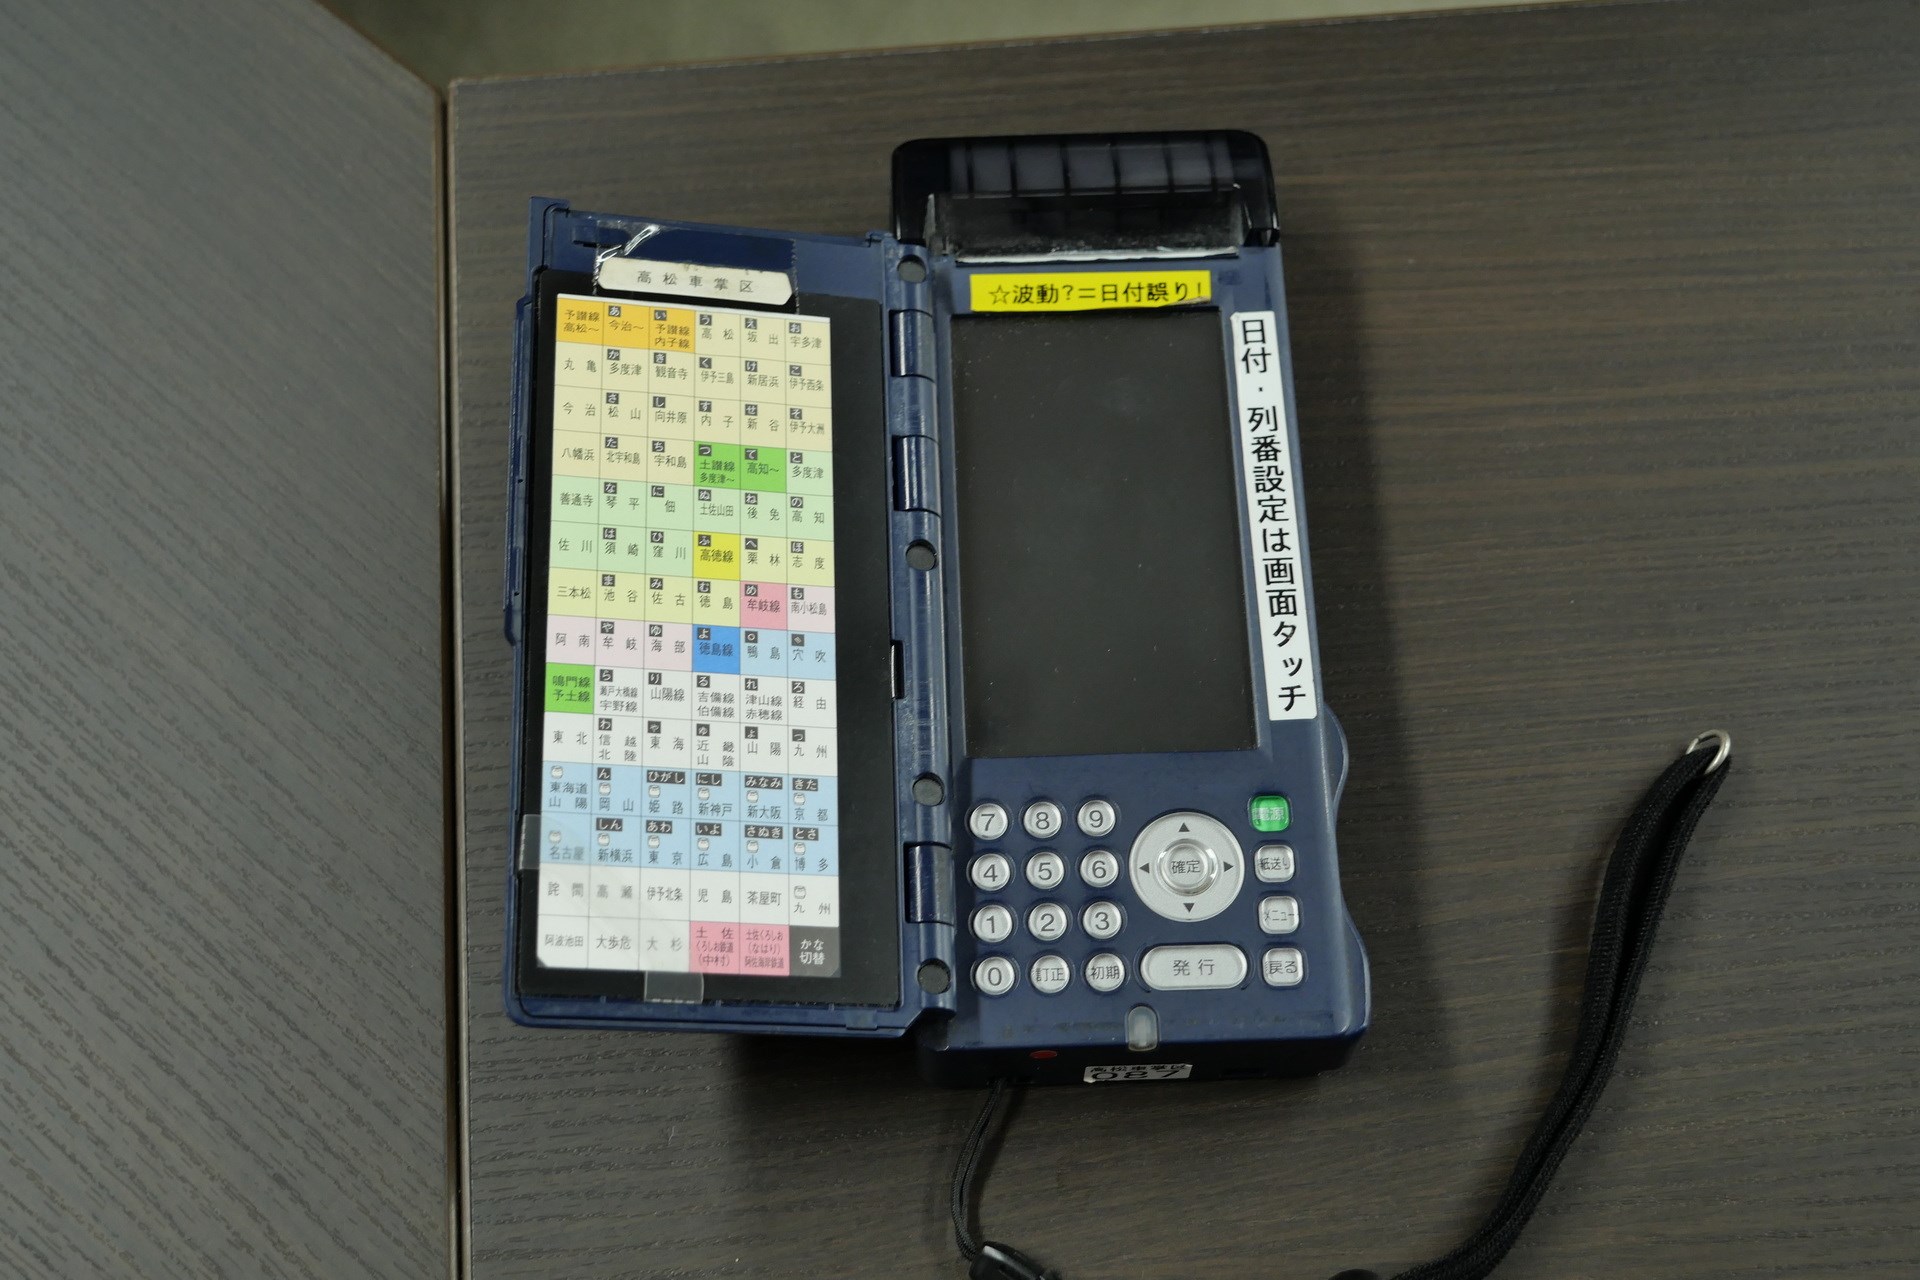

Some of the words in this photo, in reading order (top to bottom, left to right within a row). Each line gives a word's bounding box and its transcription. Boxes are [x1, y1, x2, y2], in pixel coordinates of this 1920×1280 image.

[637, 270, 754, 293] 高松車掌区
[565, 309, 600, 322] 予讃線
[655, 323, 690, 336] 予讃線
[654, 336, 690, 349] 内子線
[789, 335, 822, 349] 宇多津
[609, 361, 642, 376] 多度津
[654, 365, 688, 380] 観音寺
[700, 369, 734, 385] 伊予三島
[747, 373, 779, 388] 新居浜
[788, 376, 824, 391] 伊予西条
[654, 409, 687, 424] 向井原
[789, 420, 825, 434] 伊予大洲
[561, 447, 594, 461] 八幡浜
[606, 450, 641, 465] 北宇和島
[653, 453, 687, 469] 宇和島
[699, 458, 735, 472] 土讃線
[791, 464, 824, 479] 多度津
[664, 499, 676, 513] 佃
[699, 502, 734, 517] 土佐山田
[1241, 319, 1306, 712] 日付・列番設定は画面タッチ
[699, 548, 734, 563] 高徳線
[557, 585, 591, 599] 三本松
[790, 600, 827, 616] 南小松島
[698, 641, 733, 657] 徳島線
[552, 674, 591, 688] 鳴門線
[553, 688, 590, 703] 予土線
[650, 686, 685, 702] 山陽線
[698, 691, 734, 704] 吉備線
[745, 694, 782, 707] 津山線
[599, 699, 637, 713] 宇野線
[696, 705, 734, 719] 伯備線
[745, 708, 782, 721] 赤穂線
[648, 771, 684, 784] ひがし
[696, 773, 721, 785] にし
[745, 776, 781, 788] みなみ
[794, 778, 817, 790] きた
[550, 781, 587, 795] 東海道
[698, 801, 733, 817] 新神戸
[747, 804, 781, 820] 新大阪
[598, 818, 622, 830] しん
[647, 821, 671, 832] あわ
[981, 813, 995, 831] 7
[1036, 811, 1050, 830] 8
[1089, 810, 1103, 828] 9
[696, 824, 720, 835] いよ
[746, 826, 781, 839] さぬき
[794, 828, 816, 840] とさ
[549, 844, 584, 861] 名古屋
[597, 847, 632, 863] 新横浜
[1038, 862, 1052, 880] 5
[1092, 860, 1106, 878] 6
[1171, 860, 1200, 874] 確定
[1258, 857, 1291, 871] 紙送り
[983, 864, 998, 882] 4
[646, 886, 683, 901] 伊予北条
[697, 888, 733, 904] 児島
[747, 890, 782, 906] 茶屋町
[793, 901, 831, 915] 九州
[1263, 908, 1299, 922] メニュー
[986, 915, 995, 933] 1
[1040, 913, 1054, 931] 2
[1095, 912, 1109, 930] 3
[596, 934, 631, 950] 大歩危
[800, 938, 824, 951] かな
[799, 951, 825, 965] 切替
[1035, 967, 1065, 982] 訂正
[1090, 965, 1121, 982] 初期
[1173, 959, 1214, 976] 発行
[1267, 960, 1298, 975] 戻る
[987, 967, 1002, 986] 0
